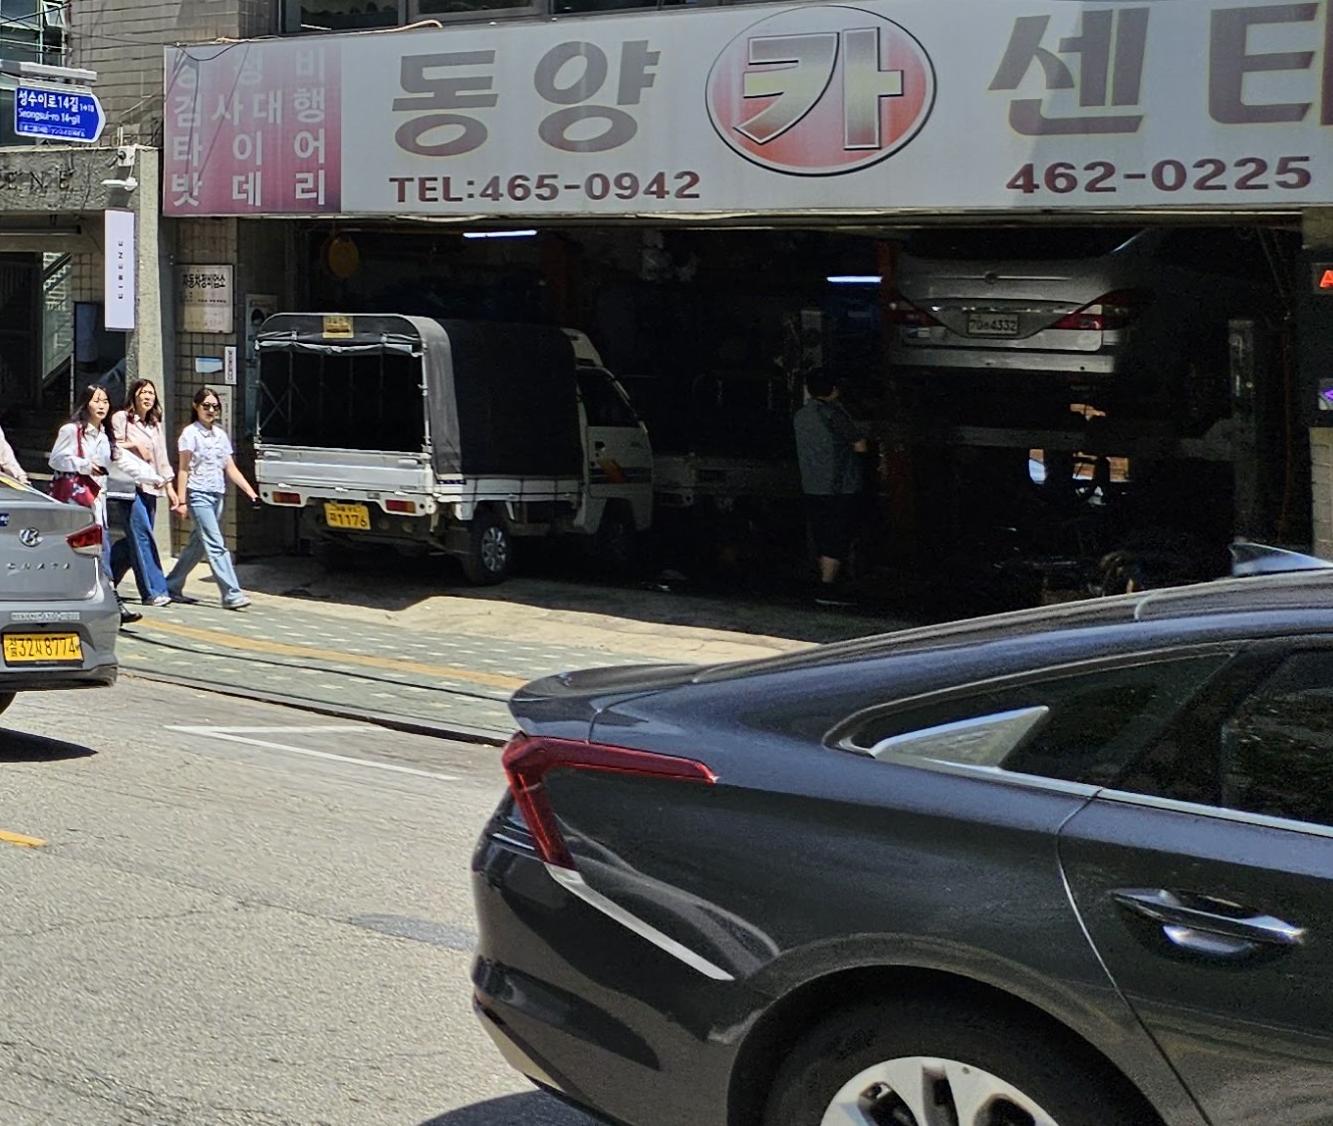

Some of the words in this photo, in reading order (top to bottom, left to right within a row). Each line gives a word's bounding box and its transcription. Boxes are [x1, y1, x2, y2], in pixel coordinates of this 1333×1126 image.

[392, 39, 661, 157] 동양
[734, 27, 904, 150] 카
[18, 108, 60, 122] Seongsui-ro
[389, 170, 701, 203] TEL:465-0942
[1006, 156, 1312, 193] 462-0225
